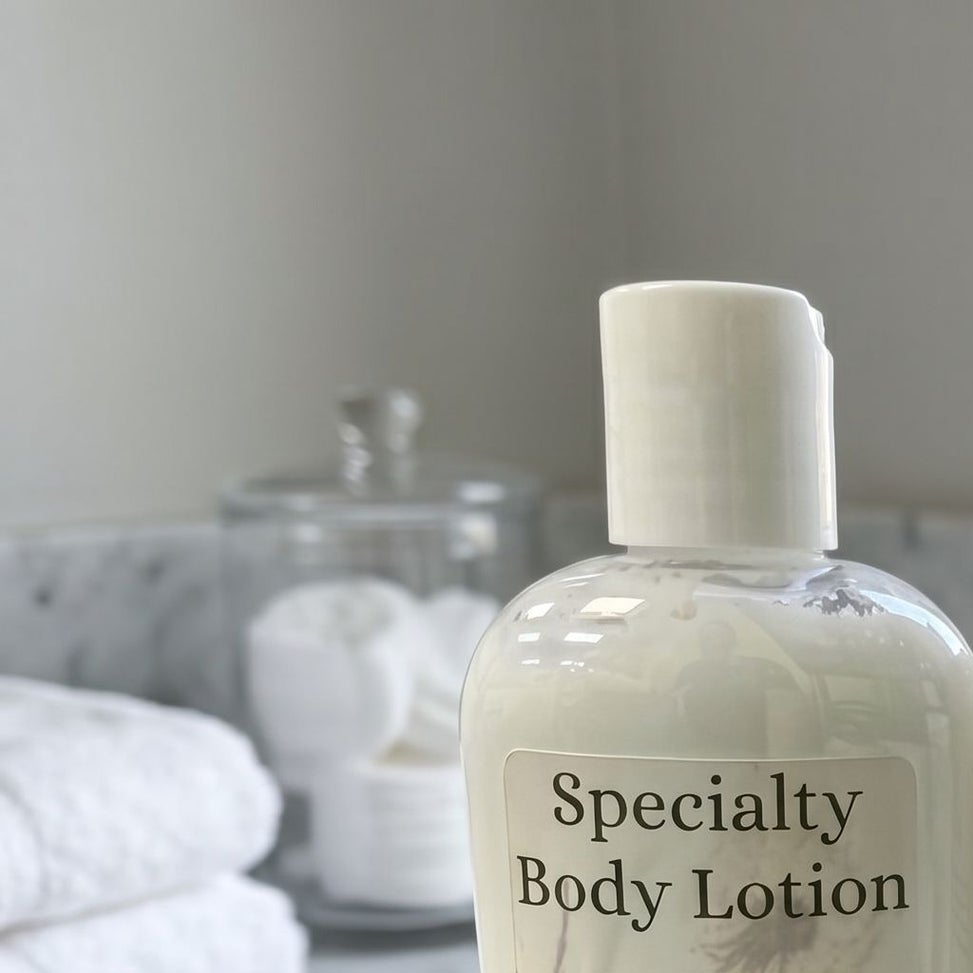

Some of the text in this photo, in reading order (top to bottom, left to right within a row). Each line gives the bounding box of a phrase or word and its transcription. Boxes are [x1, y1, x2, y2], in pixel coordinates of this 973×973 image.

[552, 772, 863, 846] Specialty
[516, 855, 910, 932] Body Lotion
